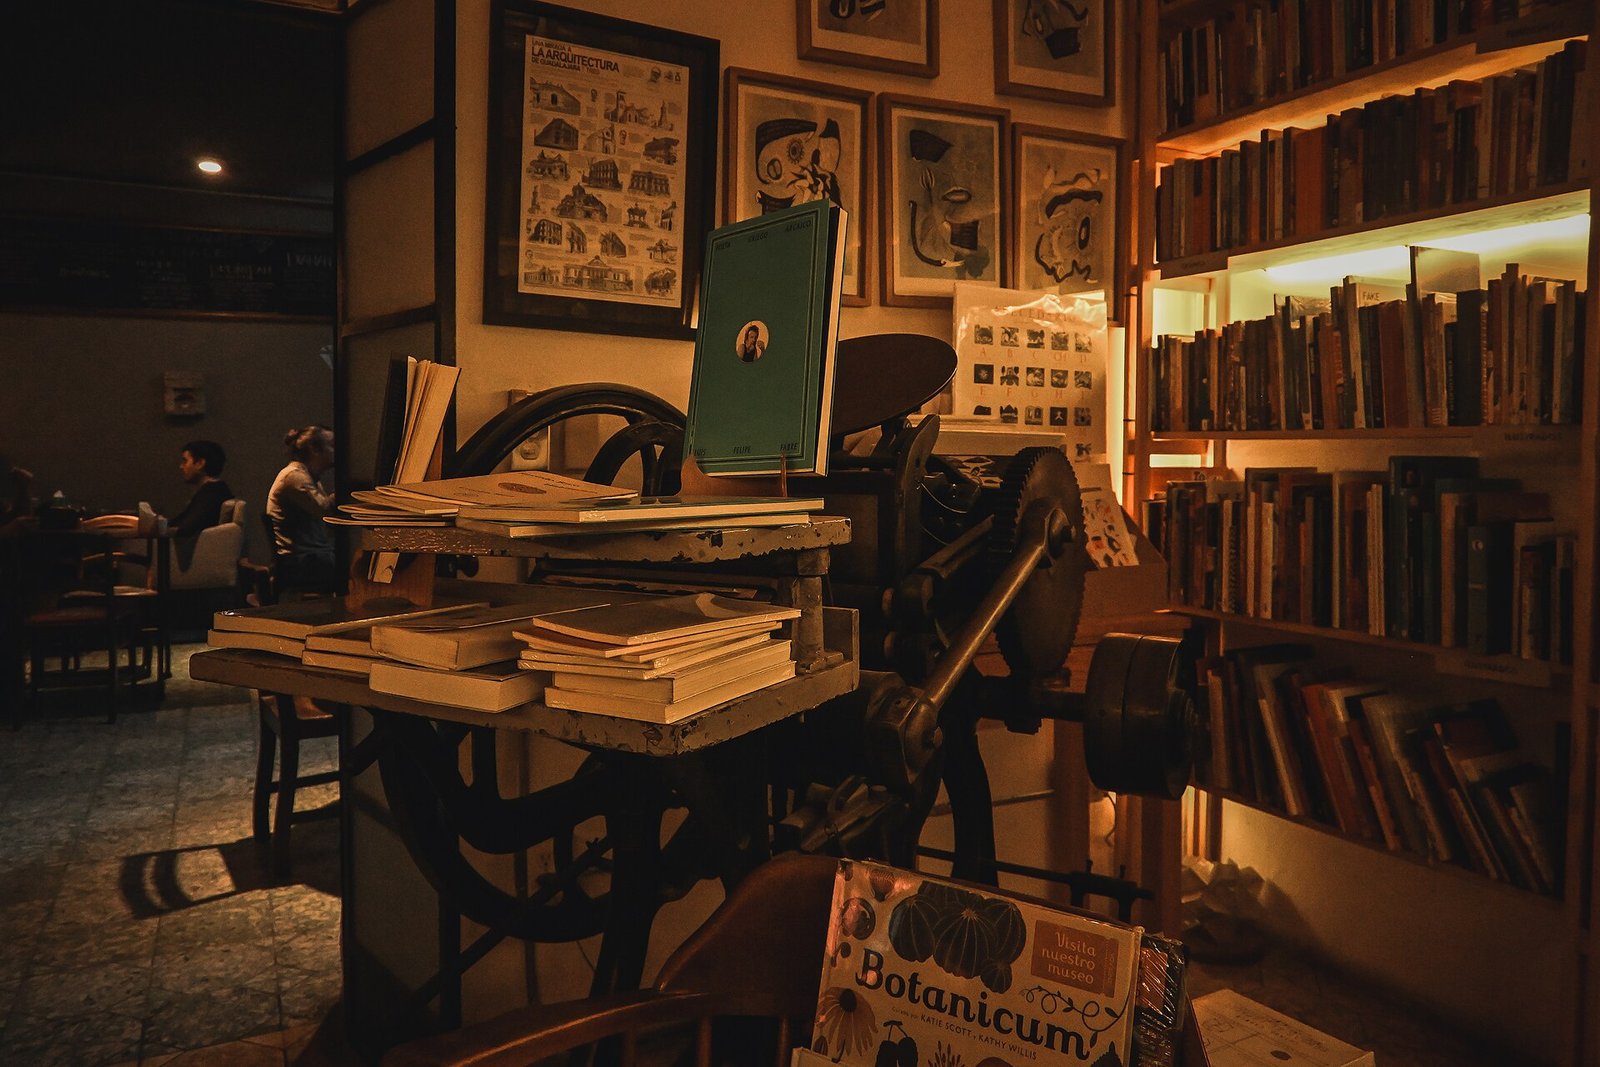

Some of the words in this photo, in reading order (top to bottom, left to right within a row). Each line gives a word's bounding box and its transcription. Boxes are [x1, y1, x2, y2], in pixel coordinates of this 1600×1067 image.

[532, 46, 545, 58] LA
[545, 49, 620, 73] ARQUITECTURA
[1362, 291, 1380, 301] FAKE
[780, 442, 798, 451] FABRE
[1055, 931, 1097, 957] Visita
[1041, 947, 1095, 970] nuestro
[1047, 963, 1094, 985] museo
[855, 947, 1091, 1061] Botanicum
[920, 1013, 944, 1029] KATIE
[945, 1021, 973, 1039] SCOTT
[978, 1034, 1008, 1050] KATHY
[1008, 1043, 1038, 1061] WILLIS
